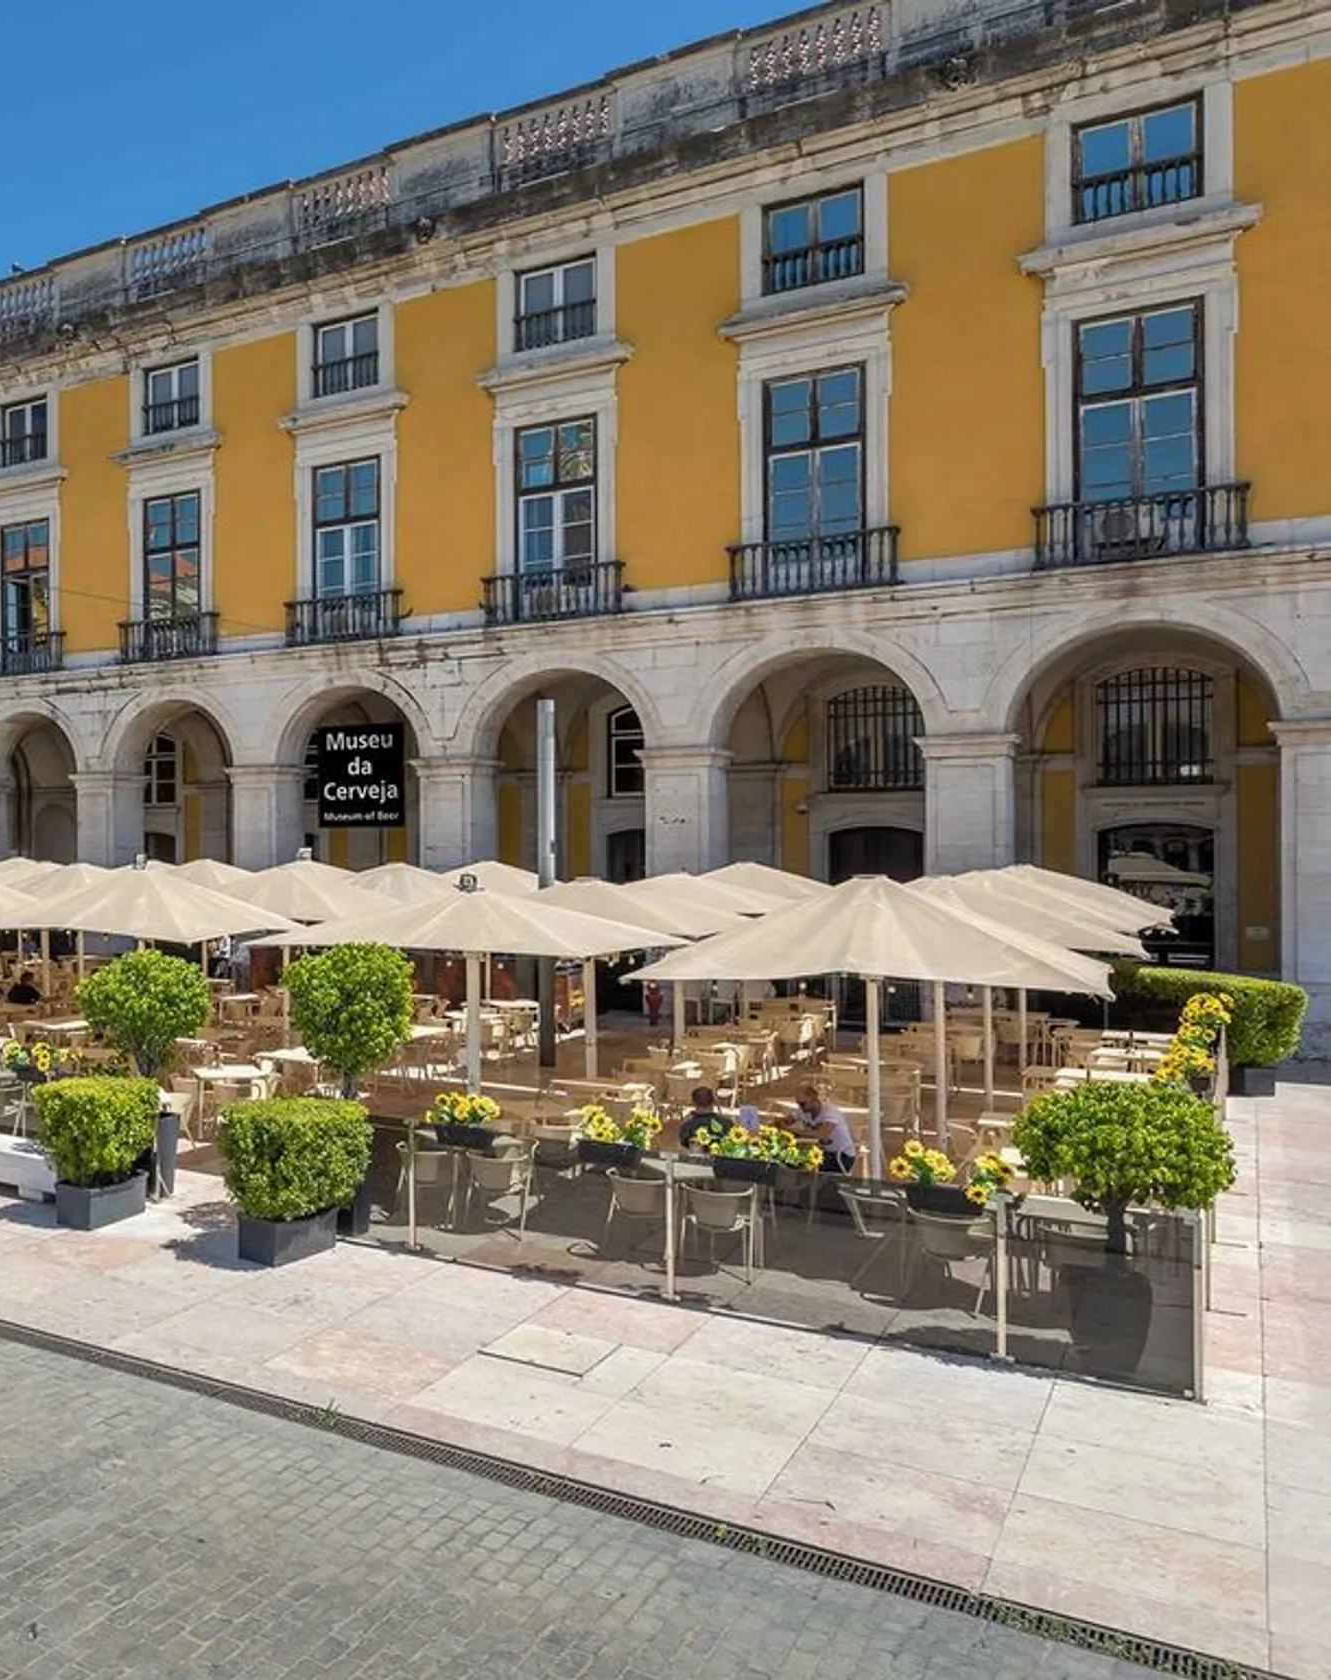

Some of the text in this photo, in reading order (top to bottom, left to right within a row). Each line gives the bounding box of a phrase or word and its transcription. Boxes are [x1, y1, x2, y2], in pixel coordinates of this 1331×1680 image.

[326, 732, 393, 751] Museu
[347, 756, 373, 776] da
[323, 780, 399, 804] Cerveja
